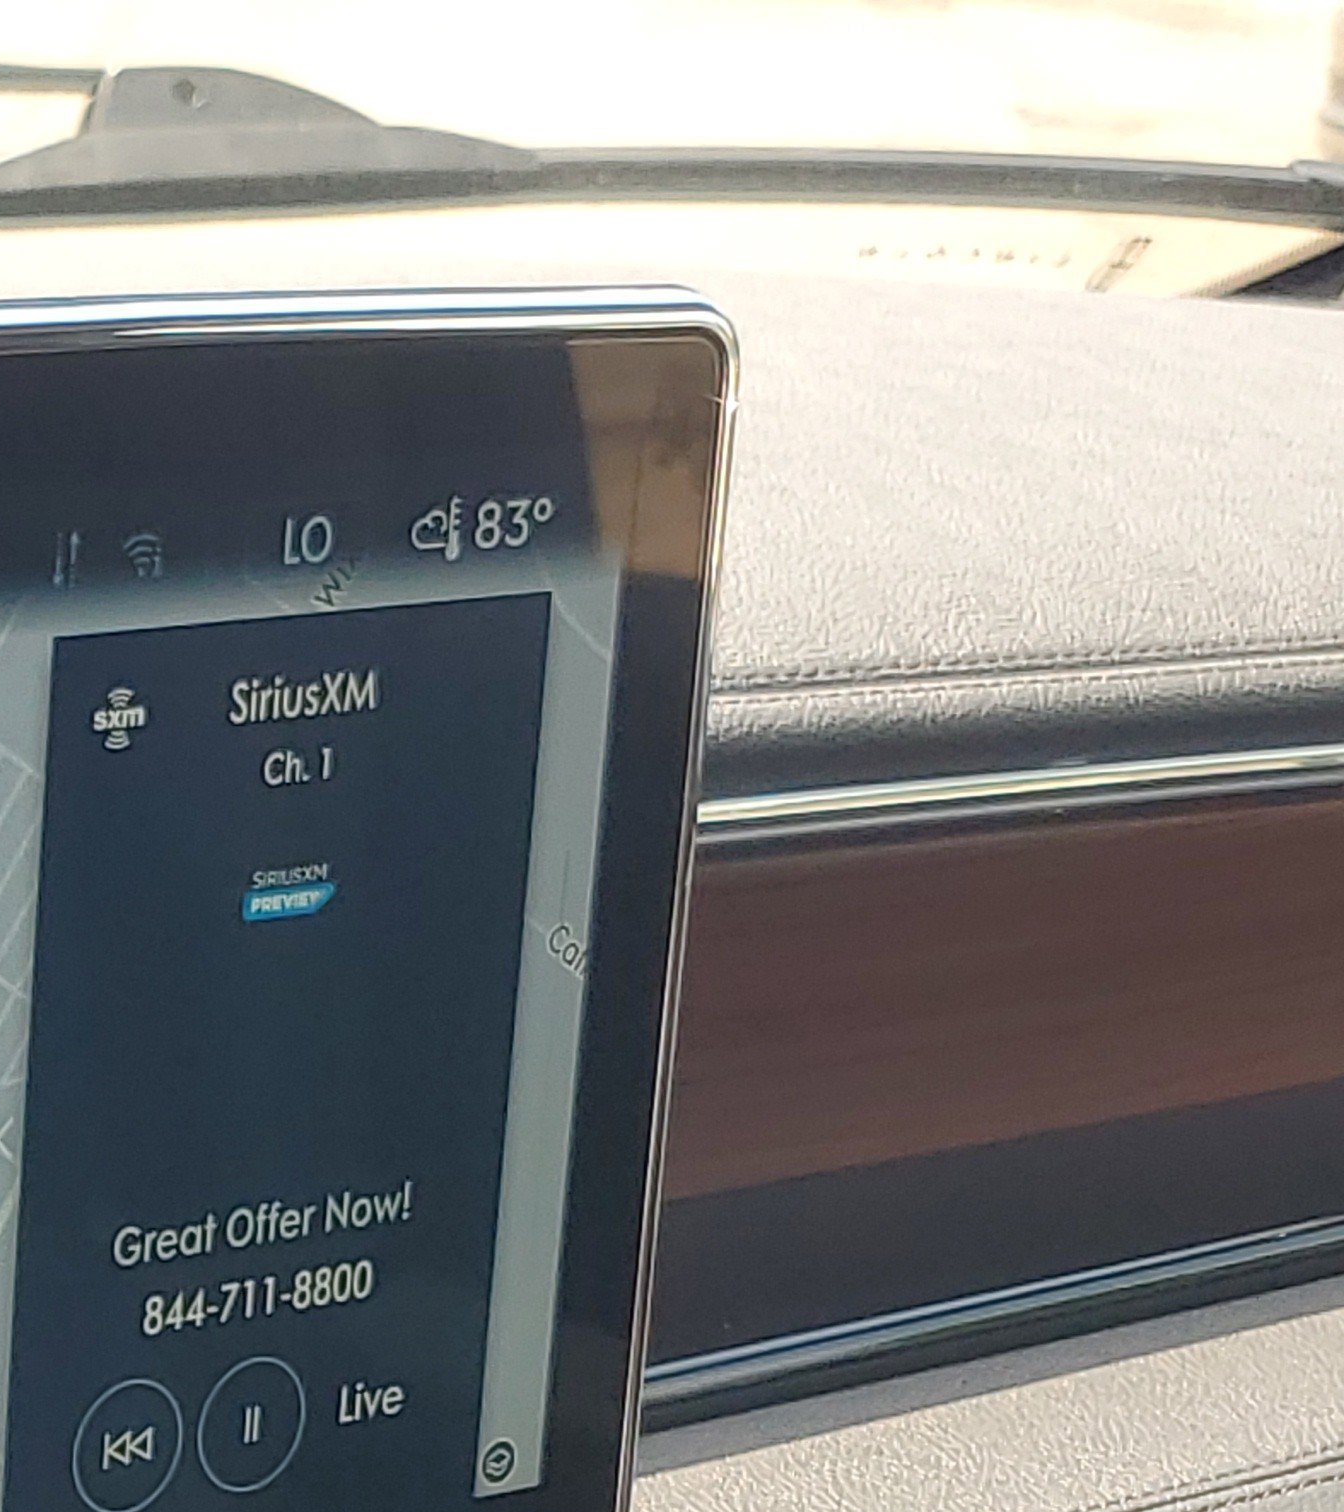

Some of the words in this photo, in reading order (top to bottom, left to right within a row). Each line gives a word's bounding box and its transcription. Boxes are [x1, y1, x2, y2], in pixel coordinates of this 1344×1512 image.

[283, 514, 333, 565] LO
[229, 671, 379, 726] SiriusXM
[263, 749, 311, 787] Ch.
[321, 747, 334, 781] 1
[114, 1217, 217, 1266] Great
[227, 1202, 317, 1249] Offer
[325, 1180, 412, 1232] Now!
[142, 1260, 372, 1336] 844-711-8800
[338, 1381, 404, 1425] Live
